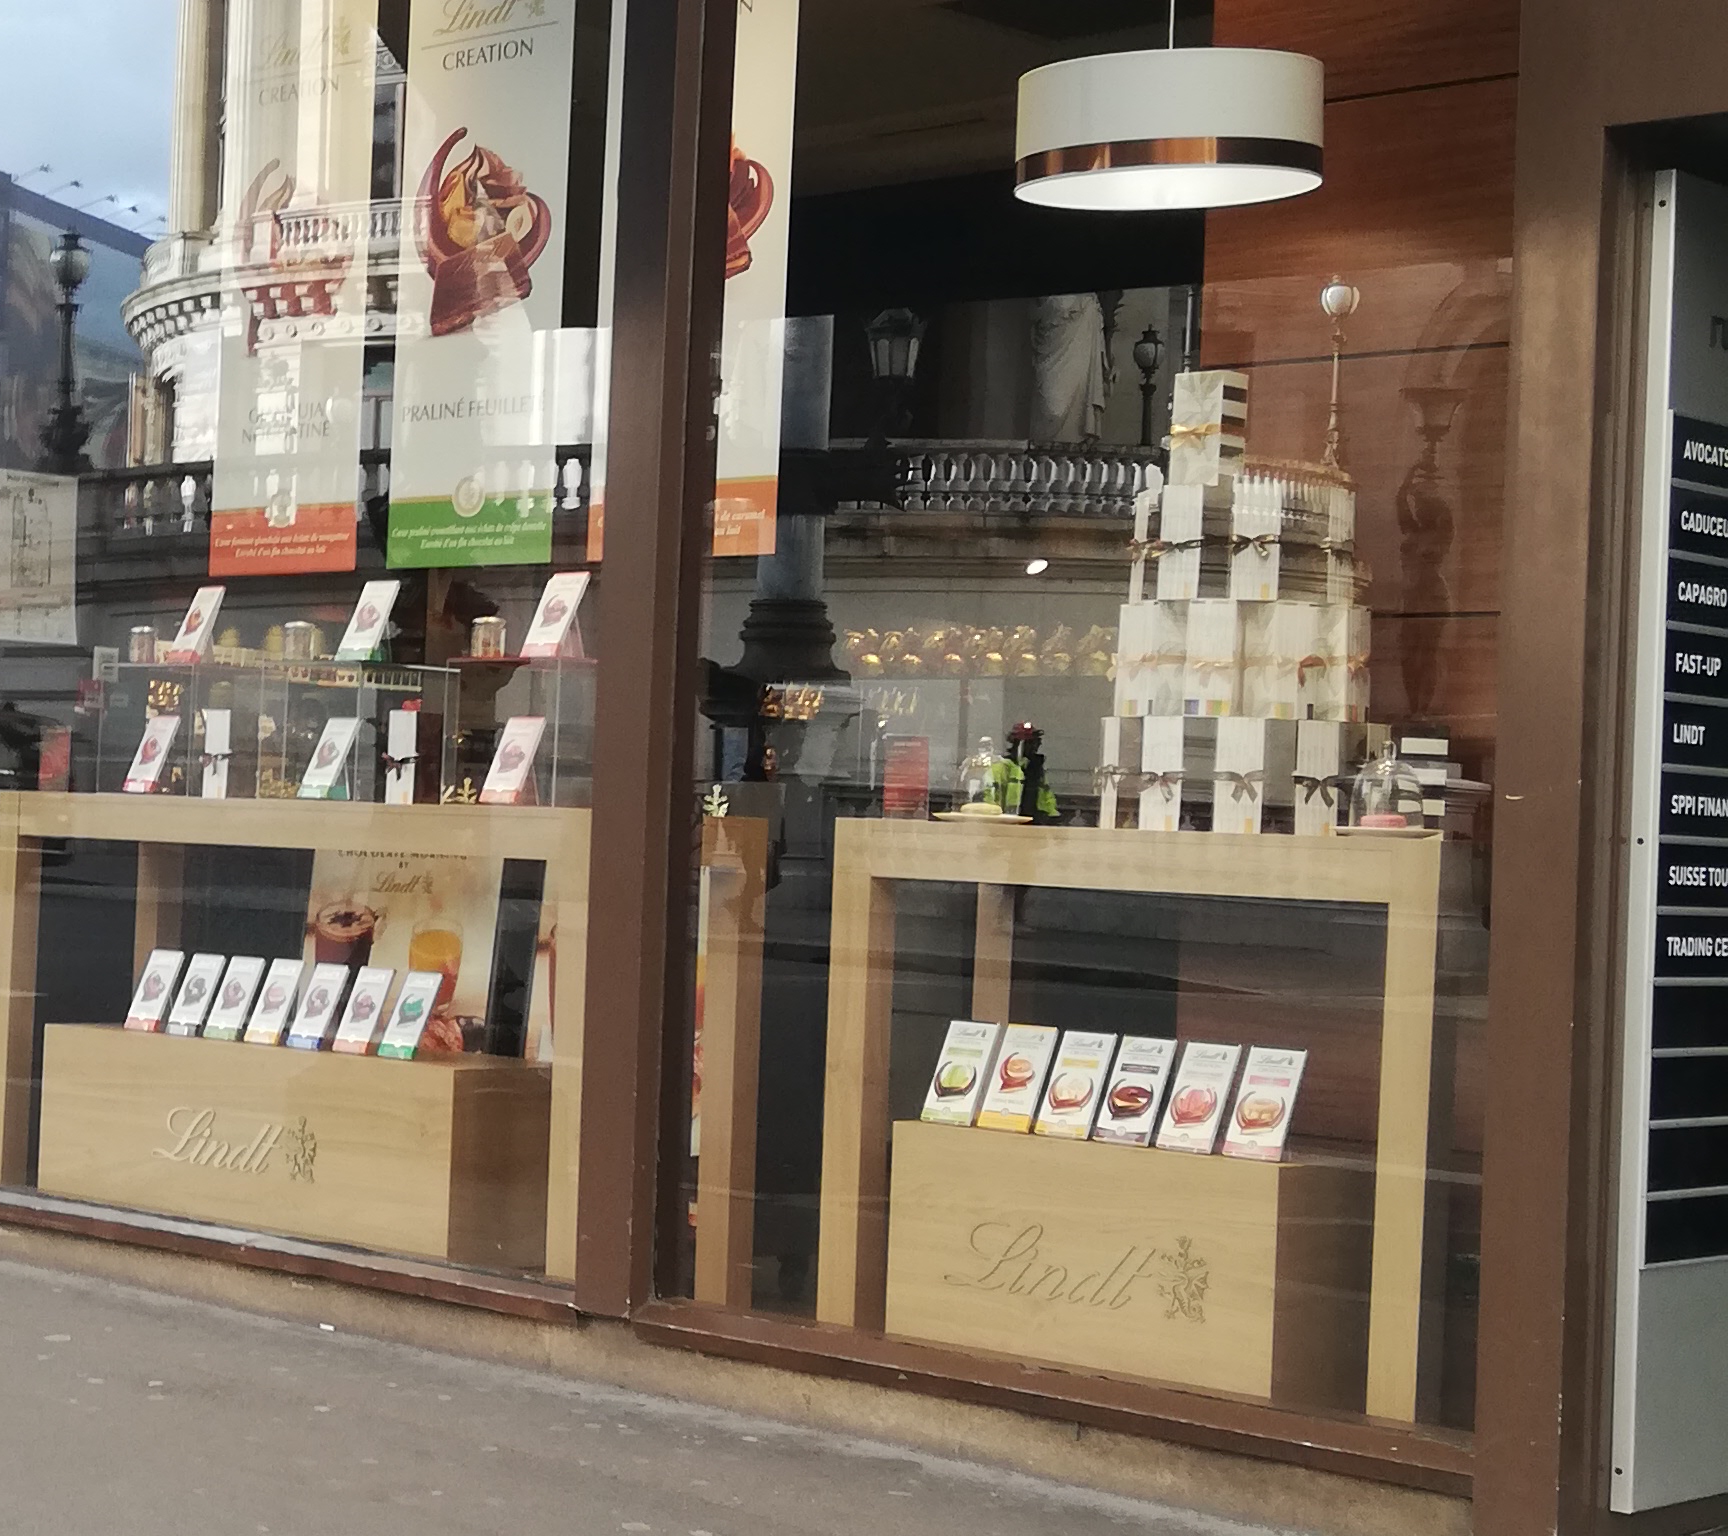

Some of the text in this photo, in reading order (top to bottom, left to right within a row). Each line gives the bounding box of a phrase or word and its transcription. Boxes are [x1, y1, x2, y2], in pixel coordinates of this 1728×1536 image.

[442, 37, 534, 72] CREATION
[402, 396, 465, 423] PRALINÉ
[1678, 581, 1728, 608] CAPAGRO
[1675, 652, 1722, 677] FAST-UP
[1673, 723, 1706, 746] LINDT
[1670, 794, 1696, 816] SPPI
[372, 871, 422, 894] Lindt
[1668, 865, 1707, 887] SUISSE
[1666, 936, 1713, 957] TRADING
[151, 1106, 285, 1175] Lindt
[943, 1221, 1156, 1310] Lindt
